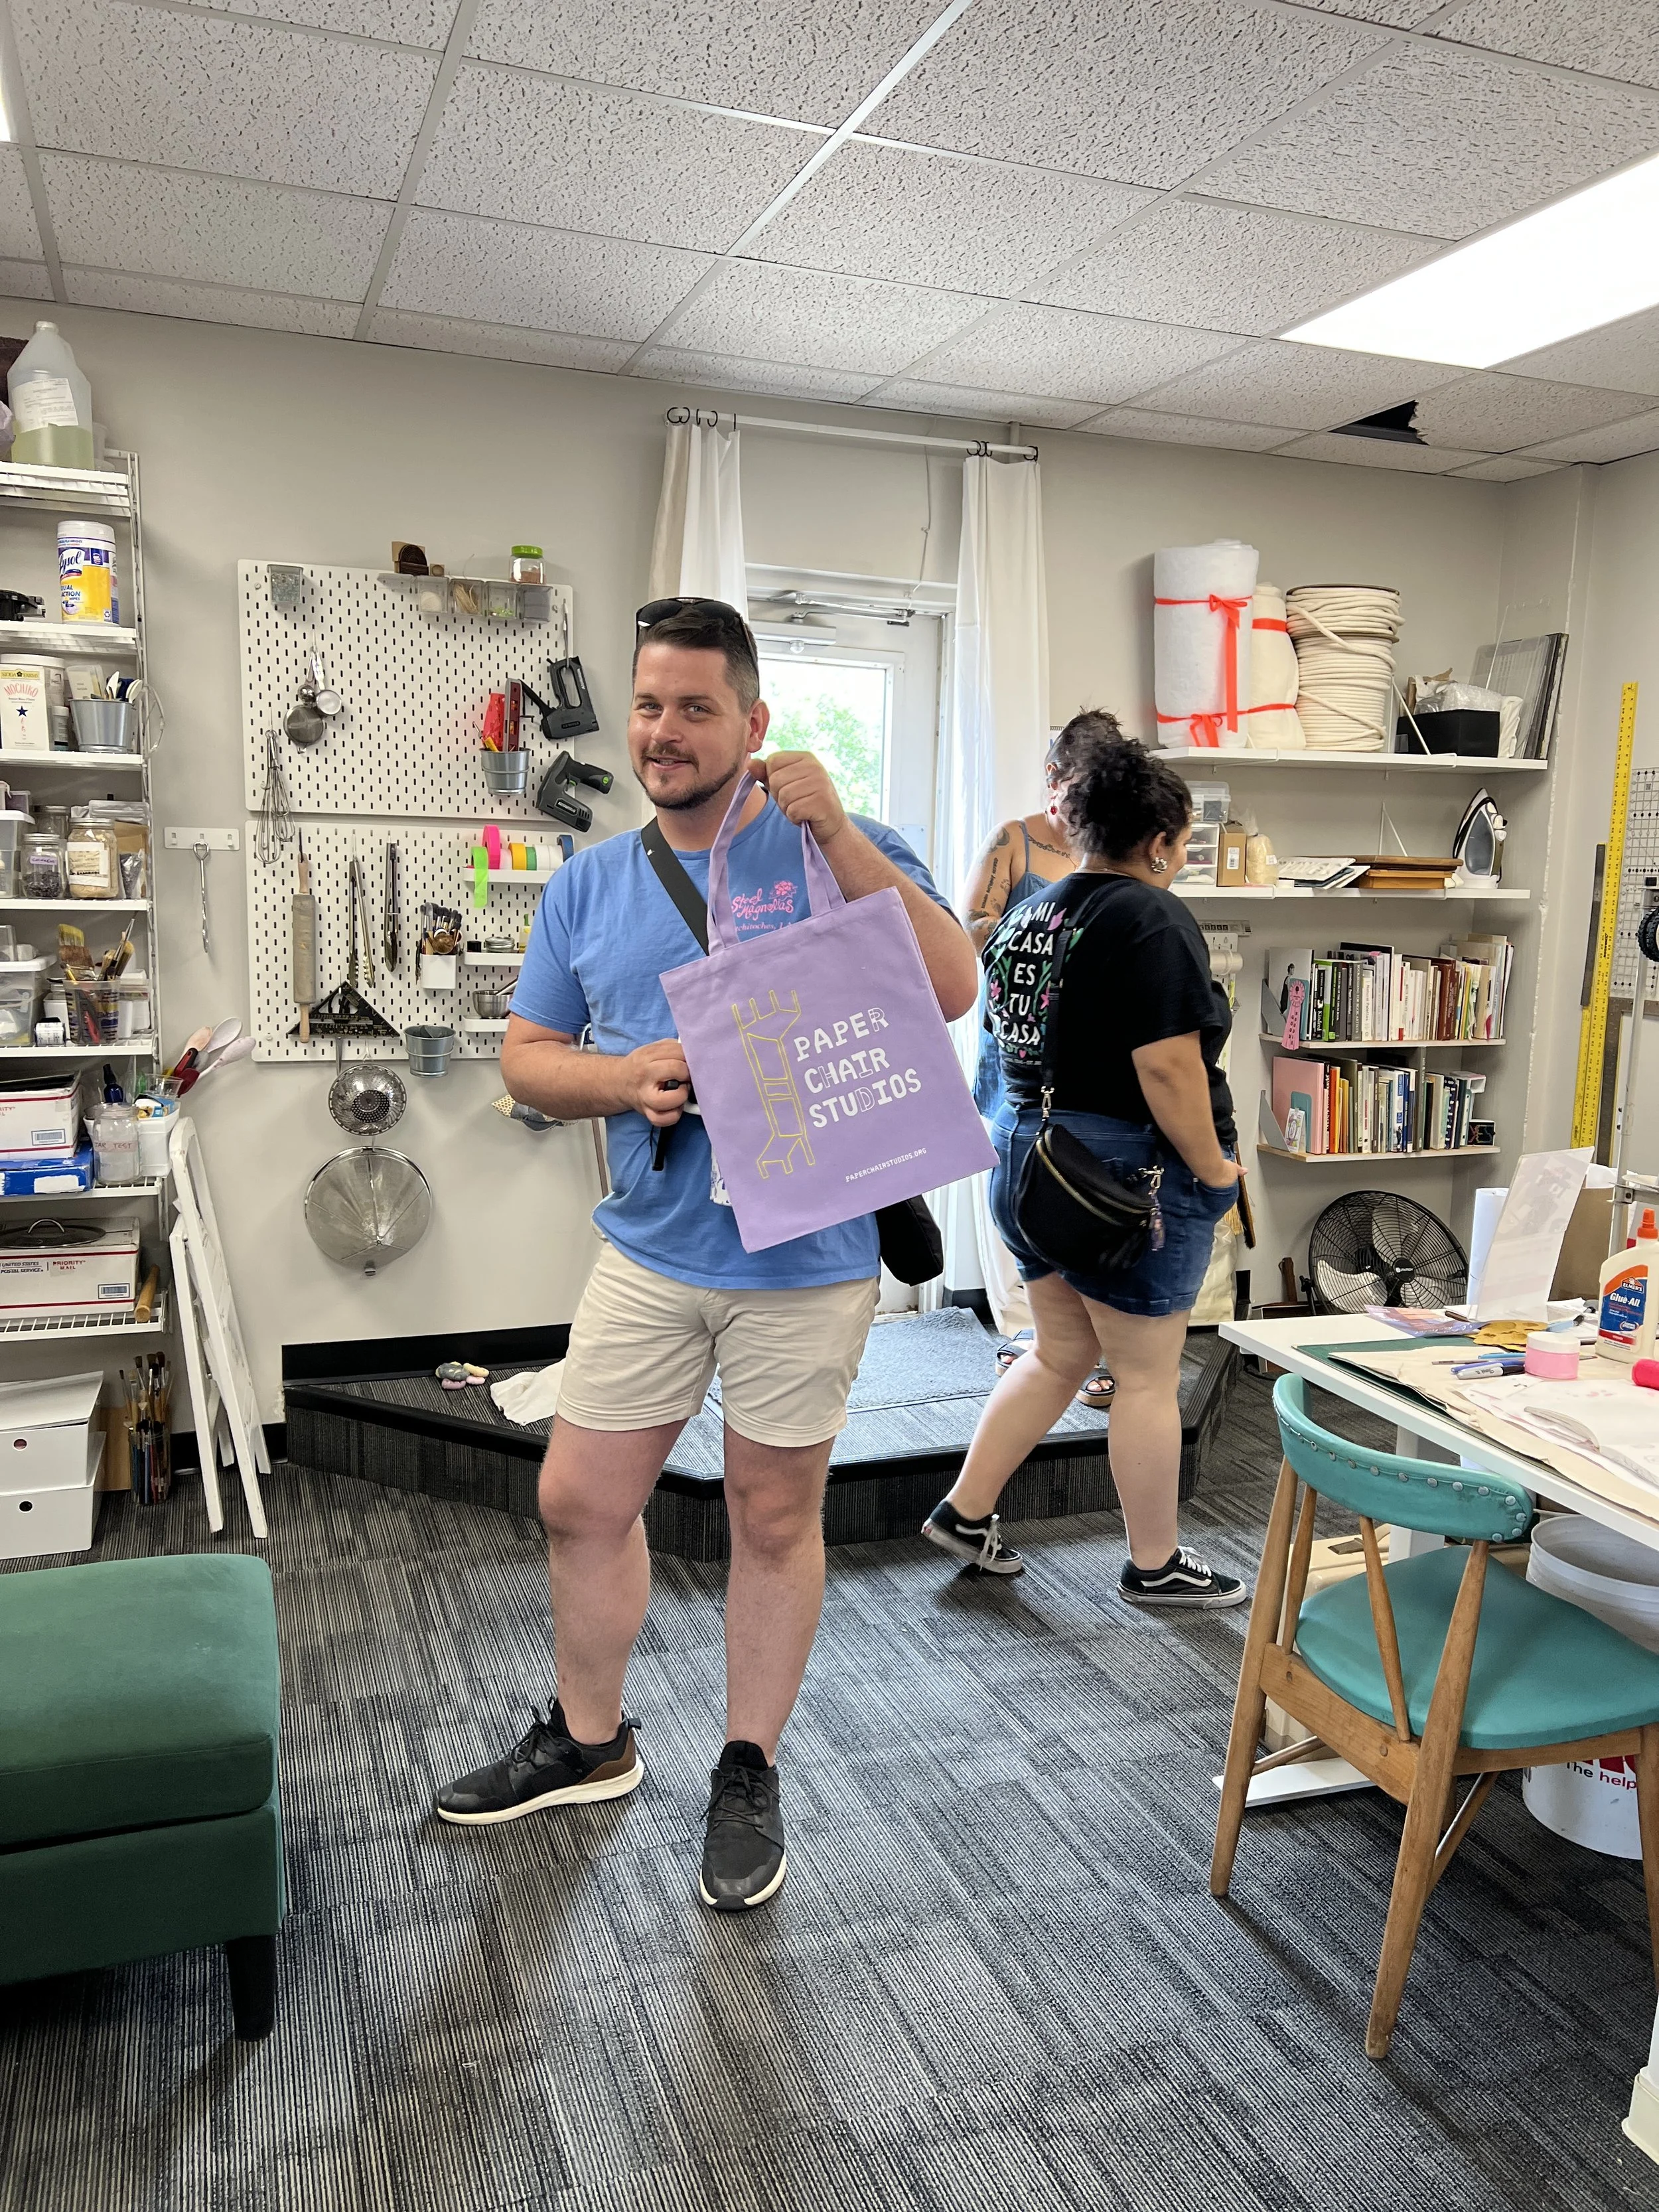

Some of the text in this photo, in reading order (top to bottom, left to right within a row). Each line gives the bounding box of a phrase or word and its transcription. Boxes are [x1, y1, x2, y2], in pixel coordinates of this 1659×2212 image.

[60, 550, 81, 575] Lysol
[3, 683, 38, 698] MOCHIKO
[731, 888, 762, 913] Steel
[737, 899, 794, 921] Magnolias
[1031, 902, 1056, 922] MI
[1007, 930, 1054, 956] CASA
[1013, 962, 1037, 986] ES
[1009, 994, 1031, 1016] TU
[794, 1007, 889, 1062] PAPER
[1001, 1020, 1041, 1046] CASA
[804, 1047, 891, 1094] CHAIR
[809, 1068, 922, 1128] STUDIOS
[845, 1147, 927, 1183] PAPERCHAIRSTUDIOS.ORG
[1623, 1282, 1642, 1292] ELMER'S
